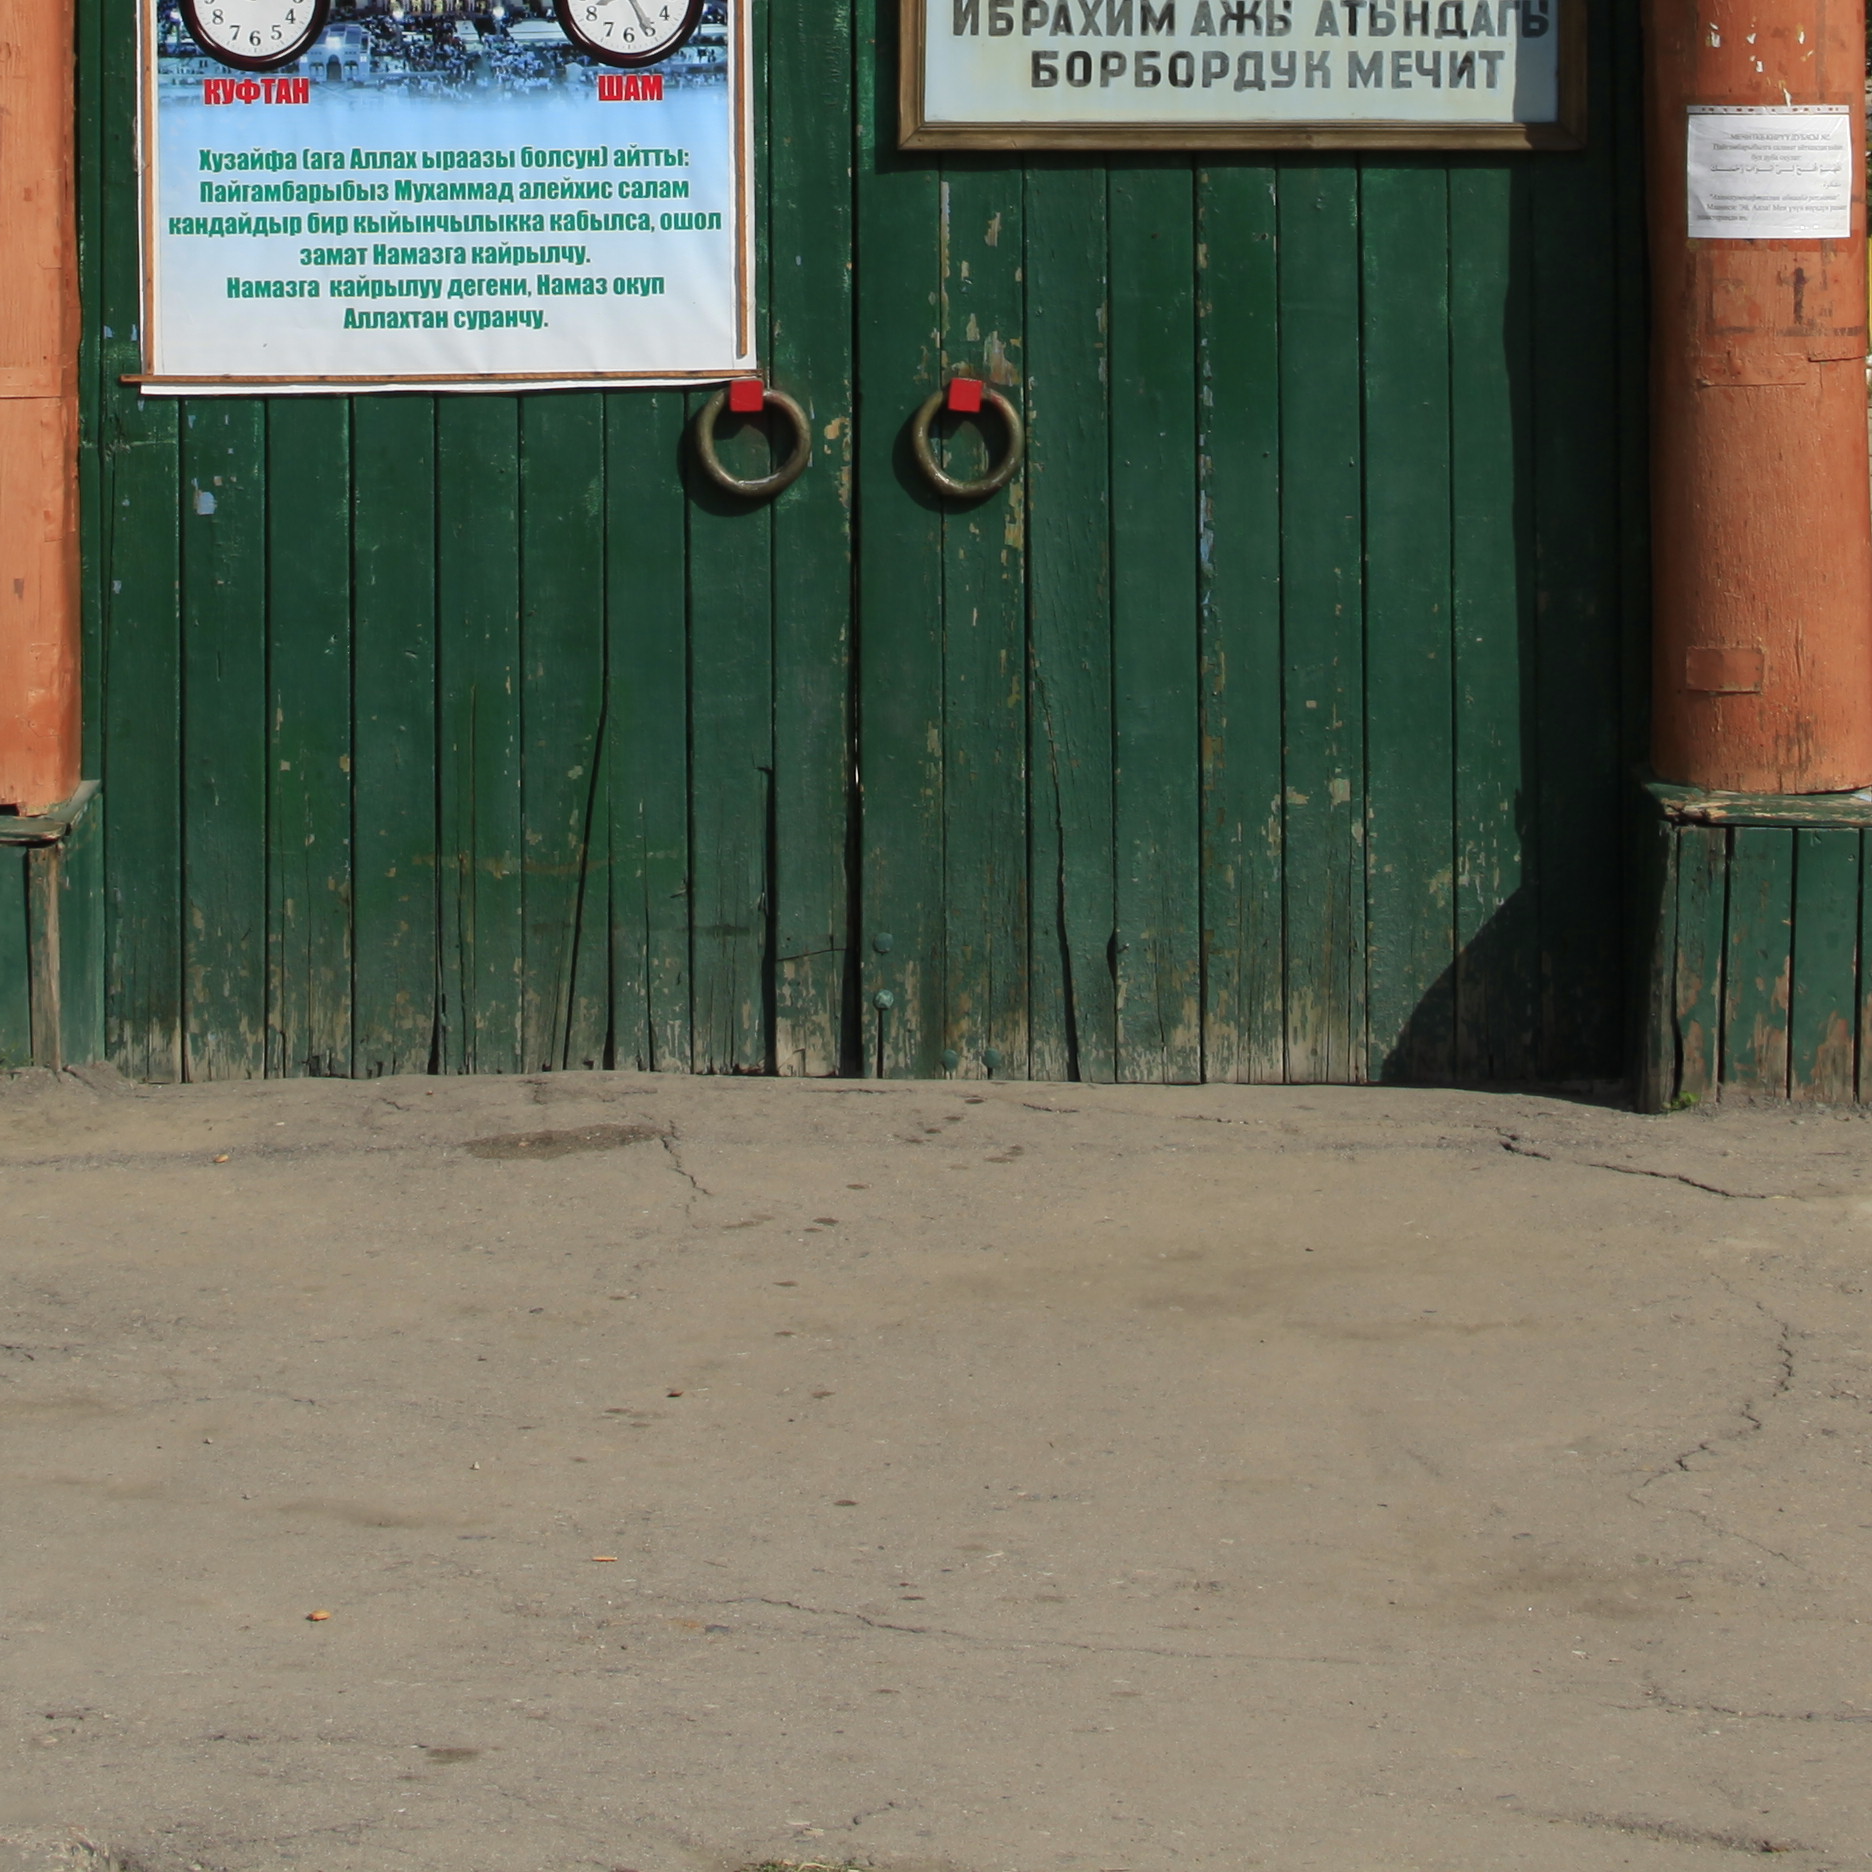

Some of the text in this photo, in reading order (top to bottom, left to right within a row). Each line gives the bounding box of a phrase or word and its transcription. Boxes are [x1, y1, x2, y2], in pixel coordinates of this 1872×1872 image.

[212, 9, 224, 25] 8
[285, 8, 296, 24] 4
[586, 6, 598, 22] 8
[659, 5, 670, 21] 4
[229, 25, 241, 41] 7
[249, 30, 261, 46] 6
[270, 25, 282, 40] 5
[603, 21, 614, 37] 7
[623, 27, 635, 43] 6
[1031, 49, 1505, 92] БОРБОРДУК МЕЧИТ
[204, 78, 310, 105] КУФТАН
[598, 74, 664, 102] ШАМ
[199, 144, 690, 172] Хузайфа (ага Аллах ыраазы болсун) айтты:
[200, 177, 689, 204] Пайгамбарыбыз Мухаммад алейхис салам
[169, 210, 722, 237] кандайдыр бир кыйынчылыкка кабылса, ошол
[300, 241, 591, 266] замат Намазга кайрылчу.
[227, 274, 665, 299] Намазга кайрылуу дегени, Намаз окуп
[343, 308, 549, 330] Аллахтан суранчу.
